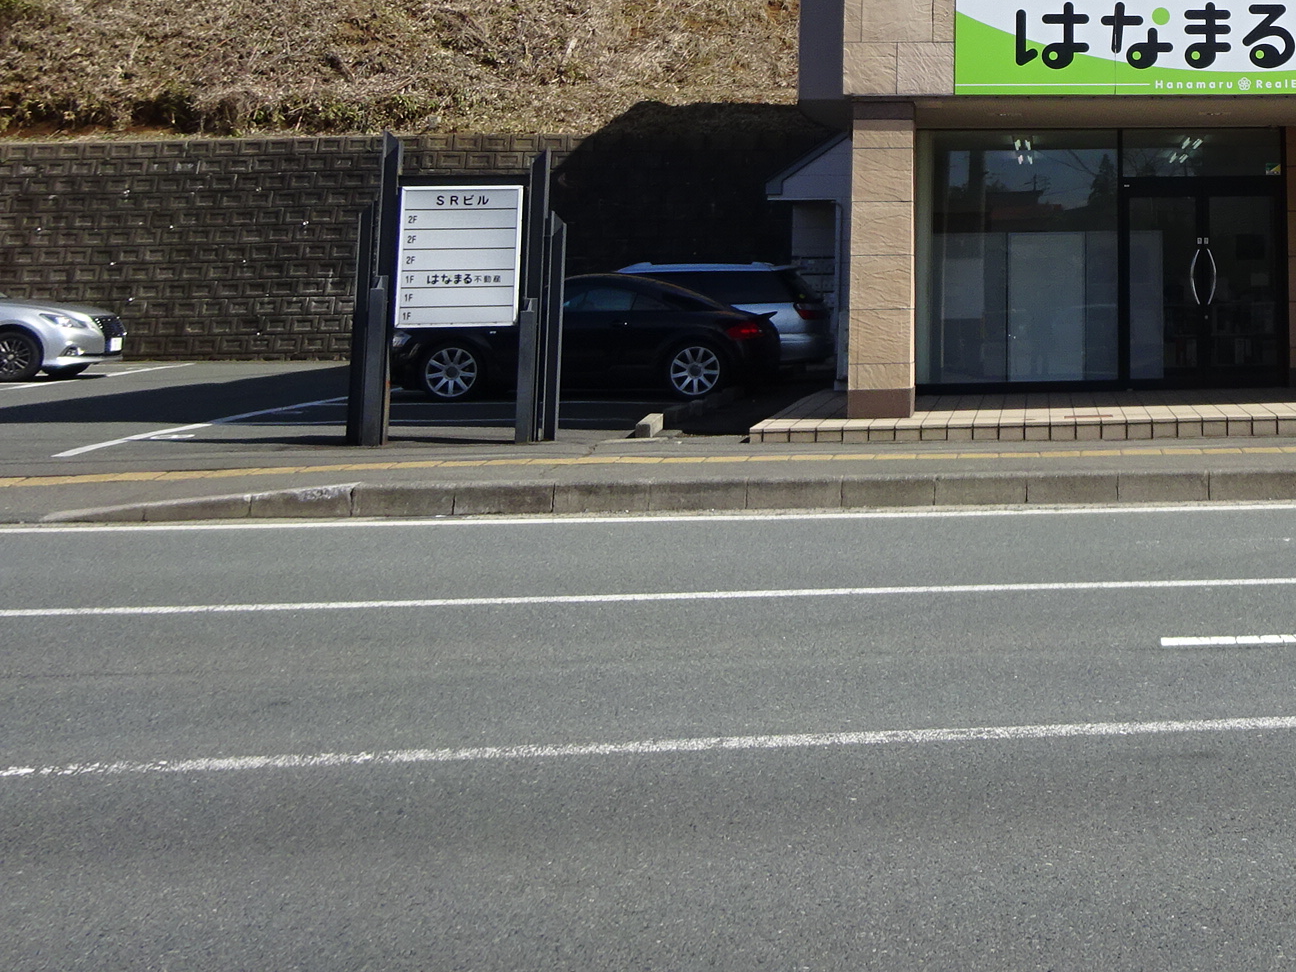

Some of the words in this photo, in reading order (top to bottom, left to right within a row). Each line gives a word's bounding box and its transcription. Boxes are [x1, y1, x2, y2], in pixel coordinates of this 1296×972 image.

[1154, 80, 1234, 90] Hanamaru
[436, 195, 490, 206] SRビル
[408, 215, 417, 224] 2F
[407, 235, 416, 244] 2F
[406, 256, 415, 265] 2F
[405, 275, 415, 284] 1F
[426, 273, 501, 285] はなまる不動産
[404, 294, 413, 302] 1F
[402, 312, 412, 321] 1F
